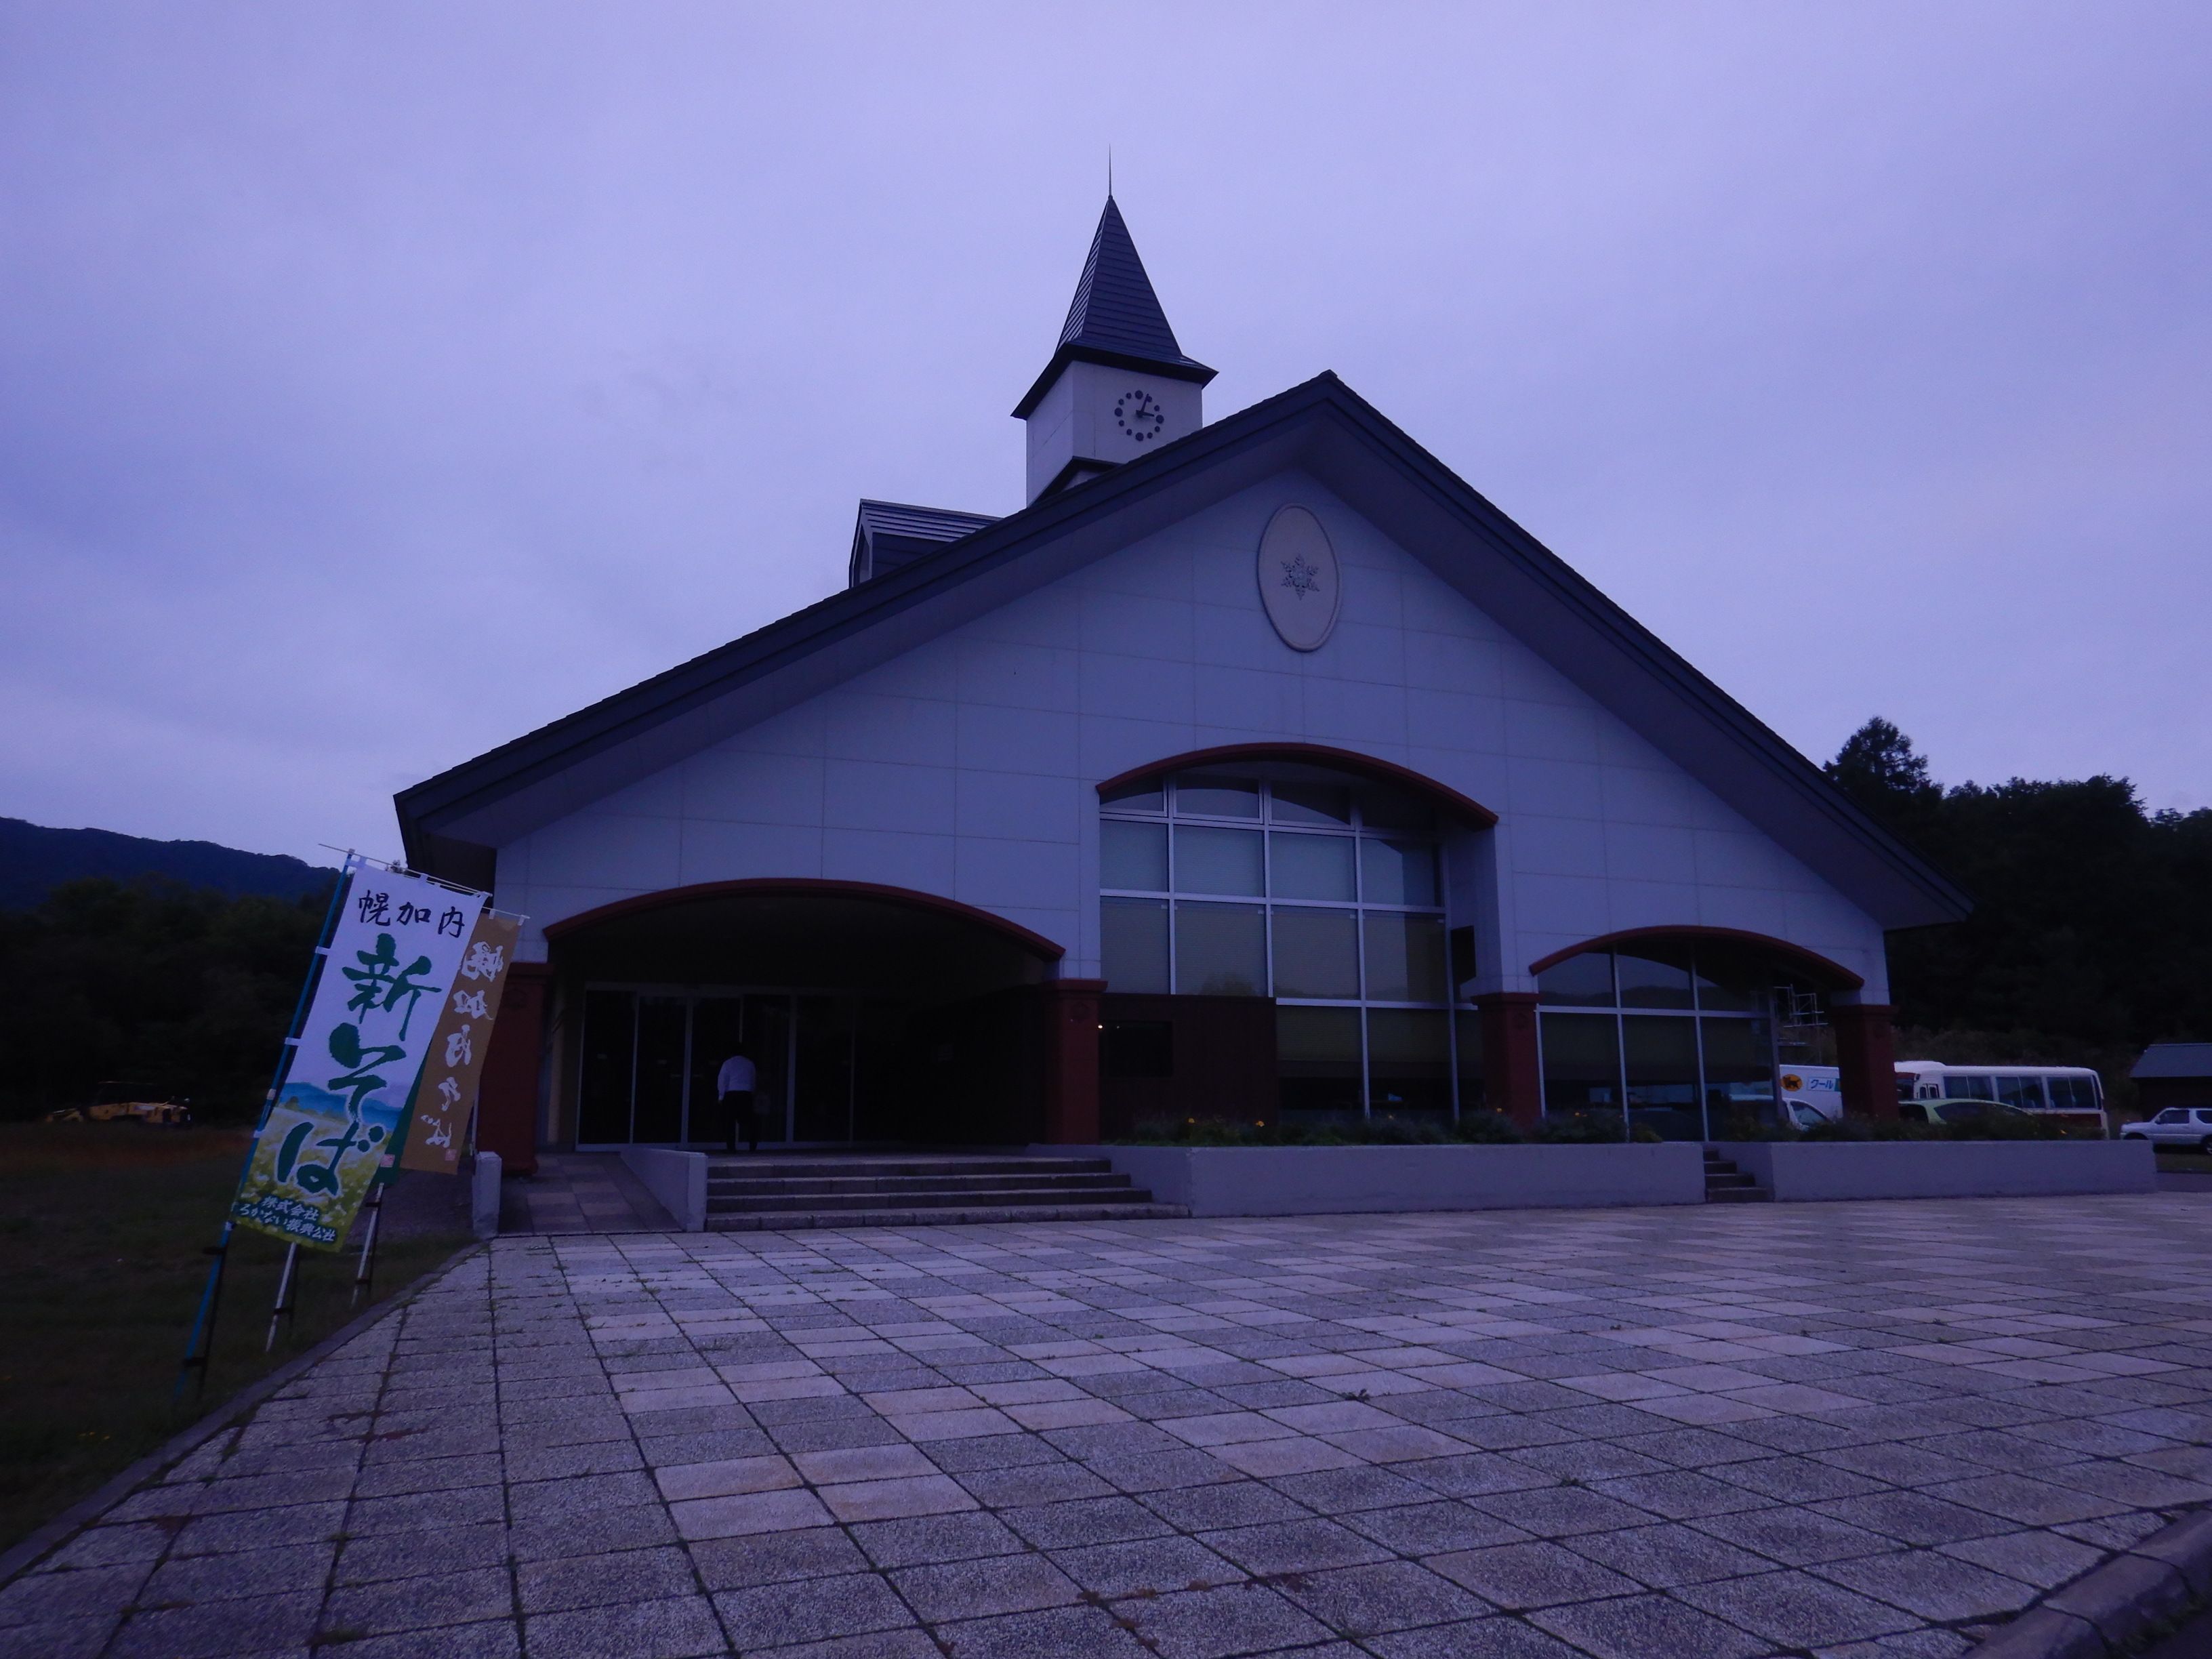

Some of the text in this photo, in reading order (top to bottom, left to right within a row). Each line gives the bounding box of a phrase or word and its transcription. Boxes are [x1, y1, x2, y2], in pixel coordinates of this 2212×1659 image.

[359, 890, 464, 937] 幌加内
[277, 933, 441, 1195] 新そば
[1811, 1080, 1834, 1089] クール
[262, 1195, 319, 1221] 株式会社
